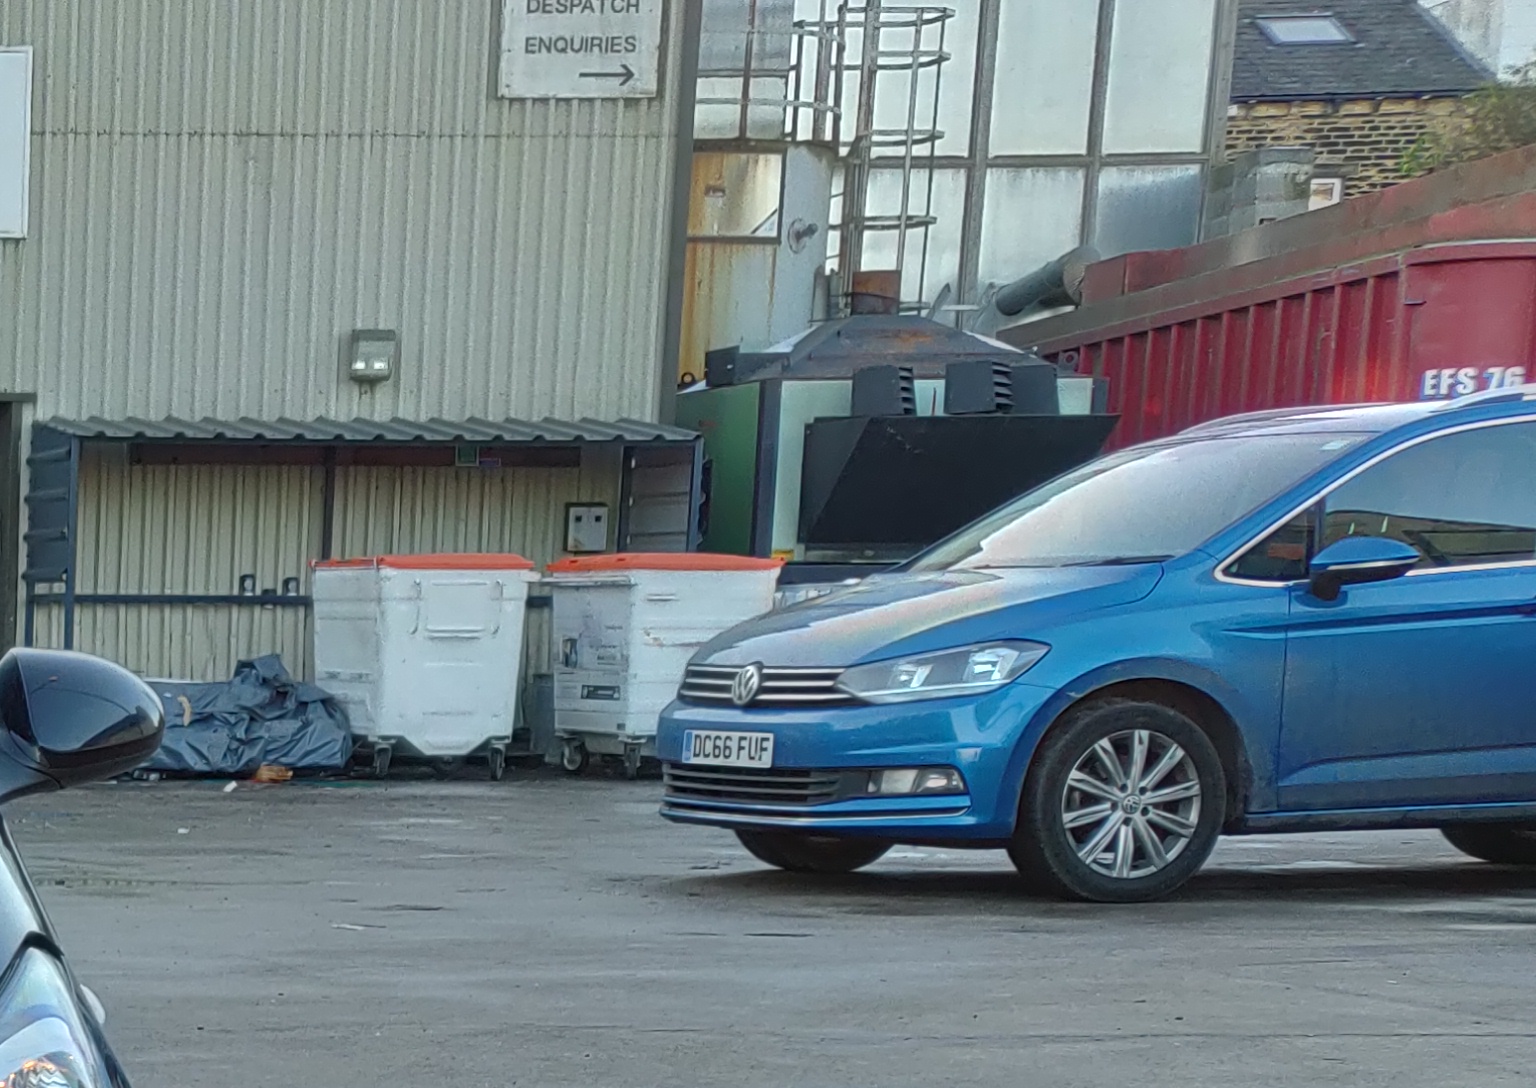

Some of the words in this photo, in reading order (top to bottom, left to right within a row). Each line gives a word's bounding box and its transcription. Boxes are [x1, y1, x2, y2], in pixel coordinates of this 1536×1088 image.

[526, 0, 640, 14] DESPATCH
[524, 36, 636, 54] ENQUIRIES
[1421, 366, 1479, 398] EFS
[693, 734, 733, 759] DC66
[736, 736, 770, 761] FUF
